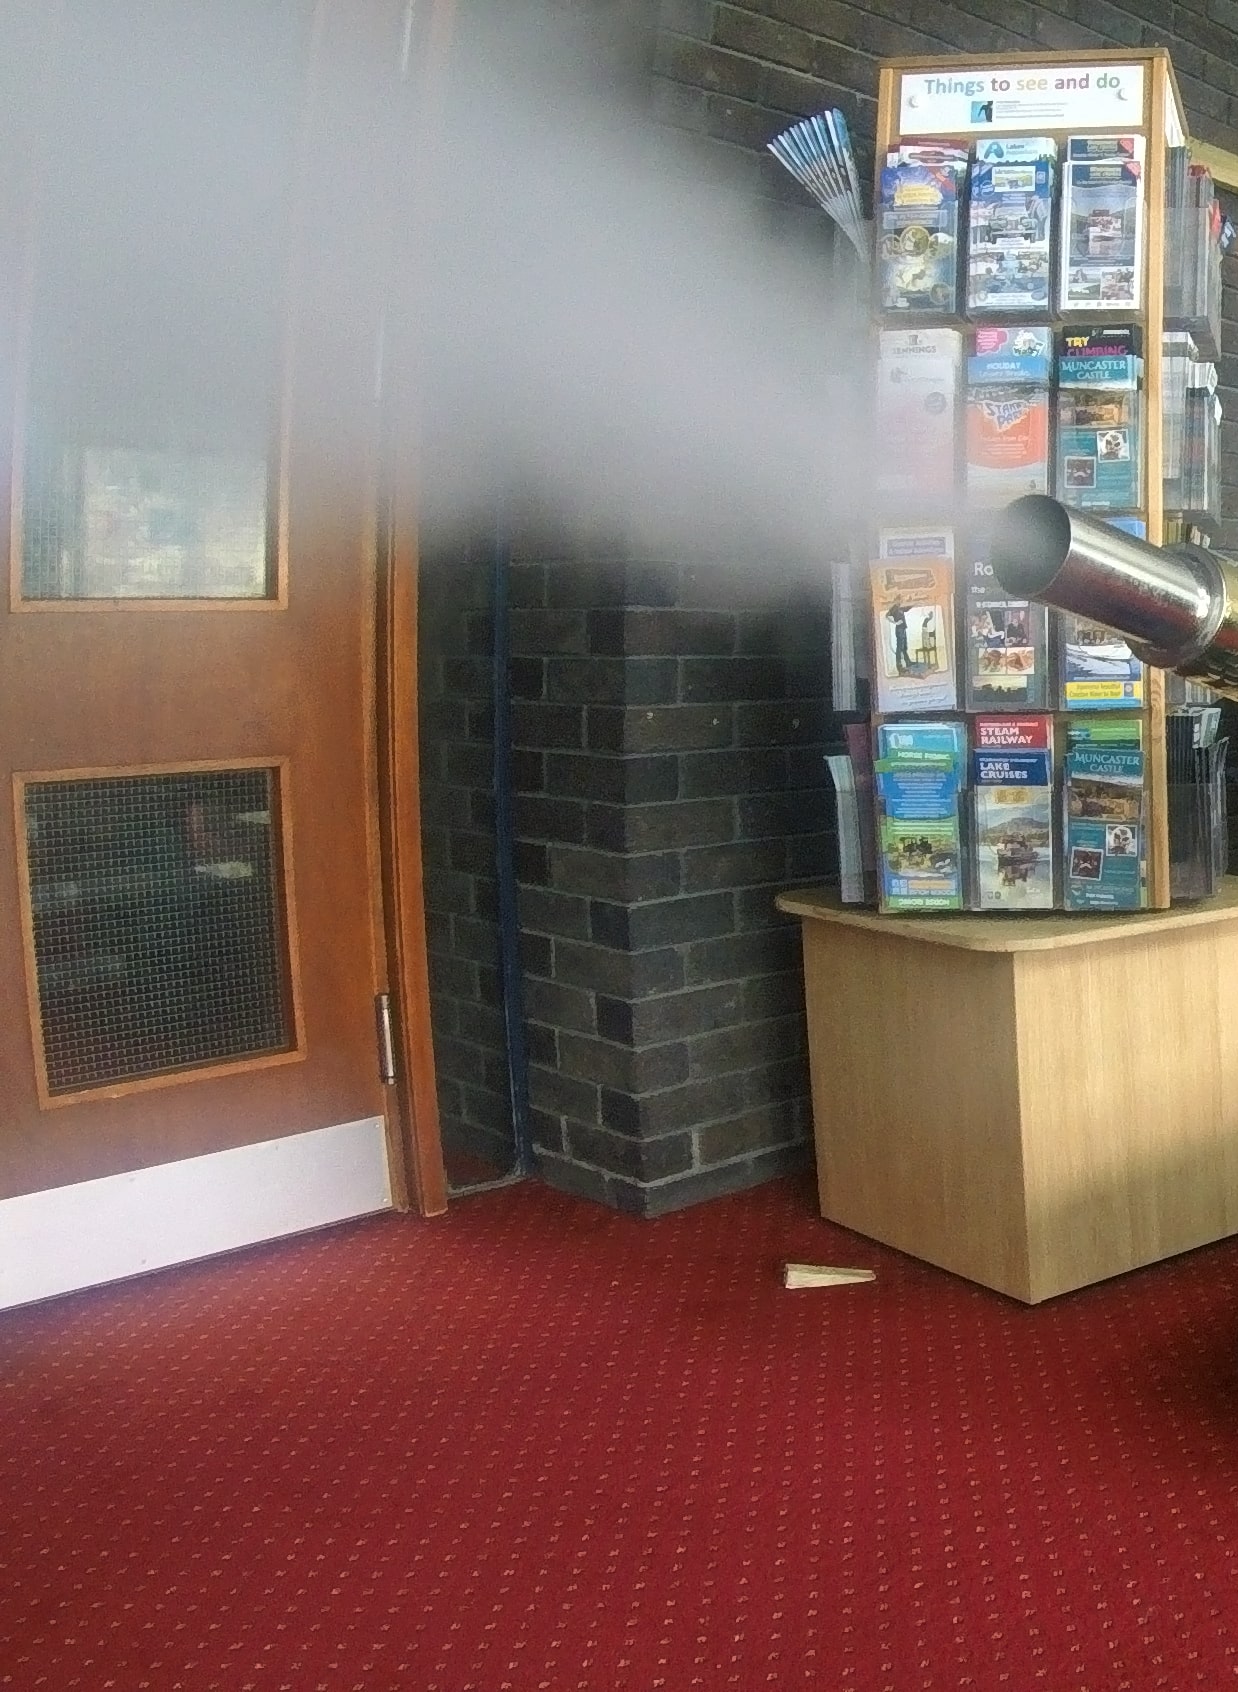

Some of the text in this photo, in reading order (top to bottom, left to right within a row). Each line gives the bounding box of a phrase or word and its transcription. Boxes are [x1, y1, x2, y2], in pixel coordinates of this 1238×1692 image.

[924, 73, 1121, 96] Things to see and do
[1065, 336, 1090, 348] TRY
[1062, 360, 1127, 372] MUNCASTER
[1076, 370, 1113, 380] CASTLE
[980, 727, 1020, 736] STEAM
[981, 735, 1033, 745] RAILWAY
[1073, 751, 1141, 766] MUNCASTER
[979, 762, 1011, 771] LAKE
[1089, 763, 1125, 773] CASTLE
[980, 770, 1028, 779] CRUISES
